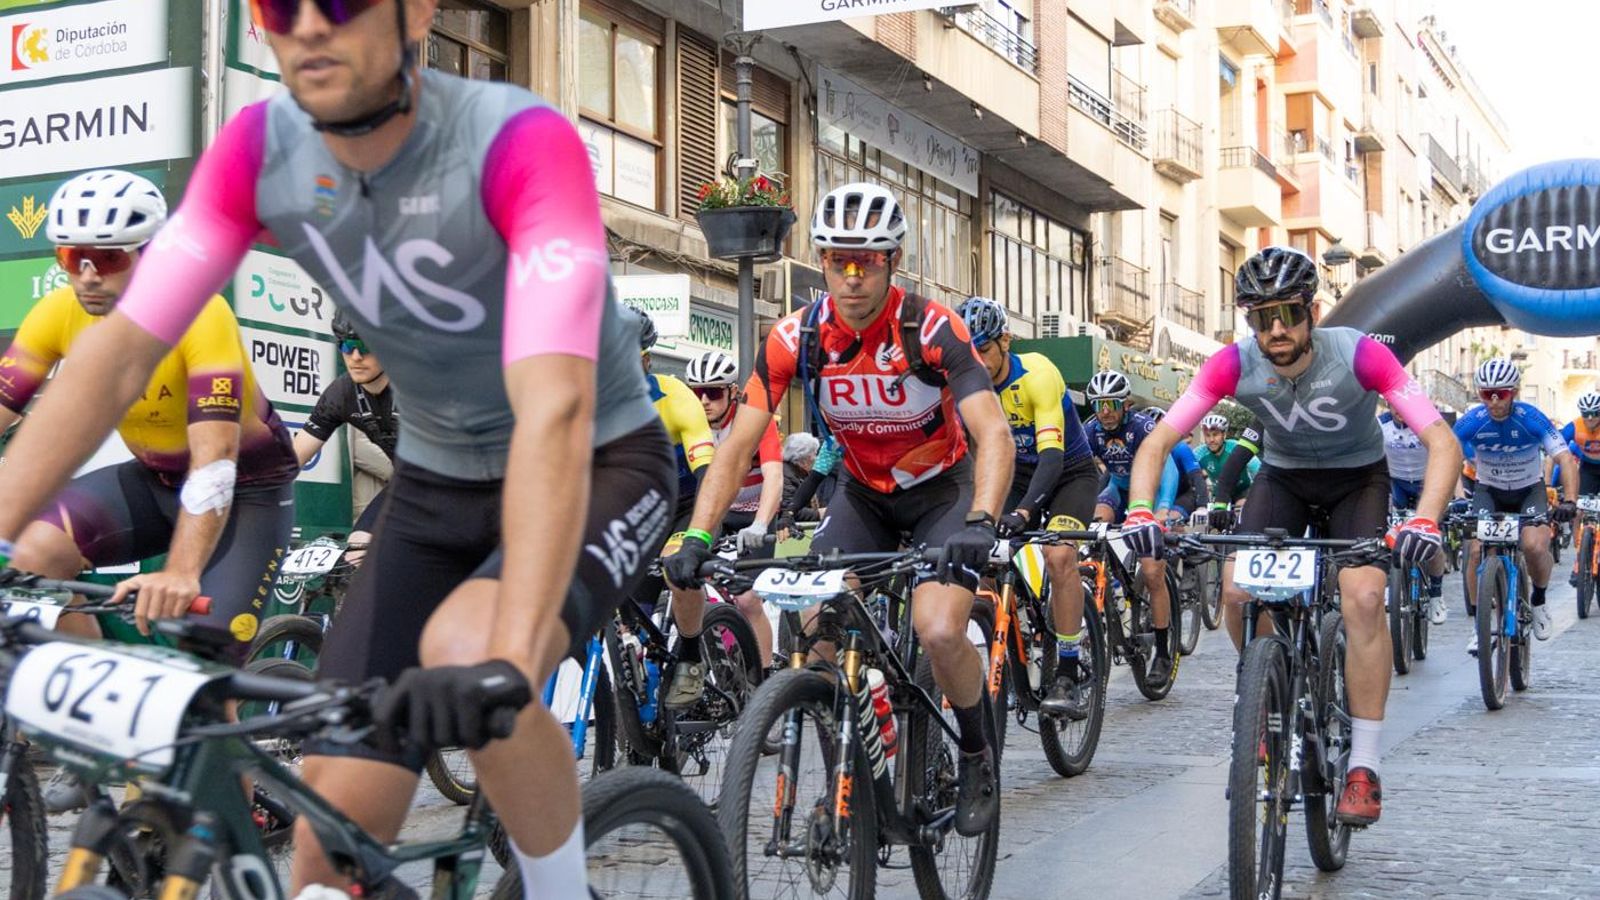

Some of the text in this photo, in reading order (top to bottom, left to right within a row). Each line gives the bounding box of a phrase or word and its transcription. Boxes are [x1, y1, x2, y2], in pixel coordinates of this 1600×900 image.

[821, 0, 904, 11] GAR
[56, 21, 127, 44] Diputación
[56, 40, 127, 60] de Córdoba
[0, 102, 148, 149] GARMIN
[689, 313, 733, 350] CNOCASA
[252, 339, 320, 372] POWER
[284, 370, 320, 396] ADE
[828, 378, 907, 407] RIU
[198, 396, 239, 408] SAESA
[867, 411, 935, 434] Committed
[1484, 522, 1513, 538] 32-2
[294, 549, 332, 568] 41-2
[1249, 553, 1302, 579] 62-2
[43, 652, 166, 738] 62-1
